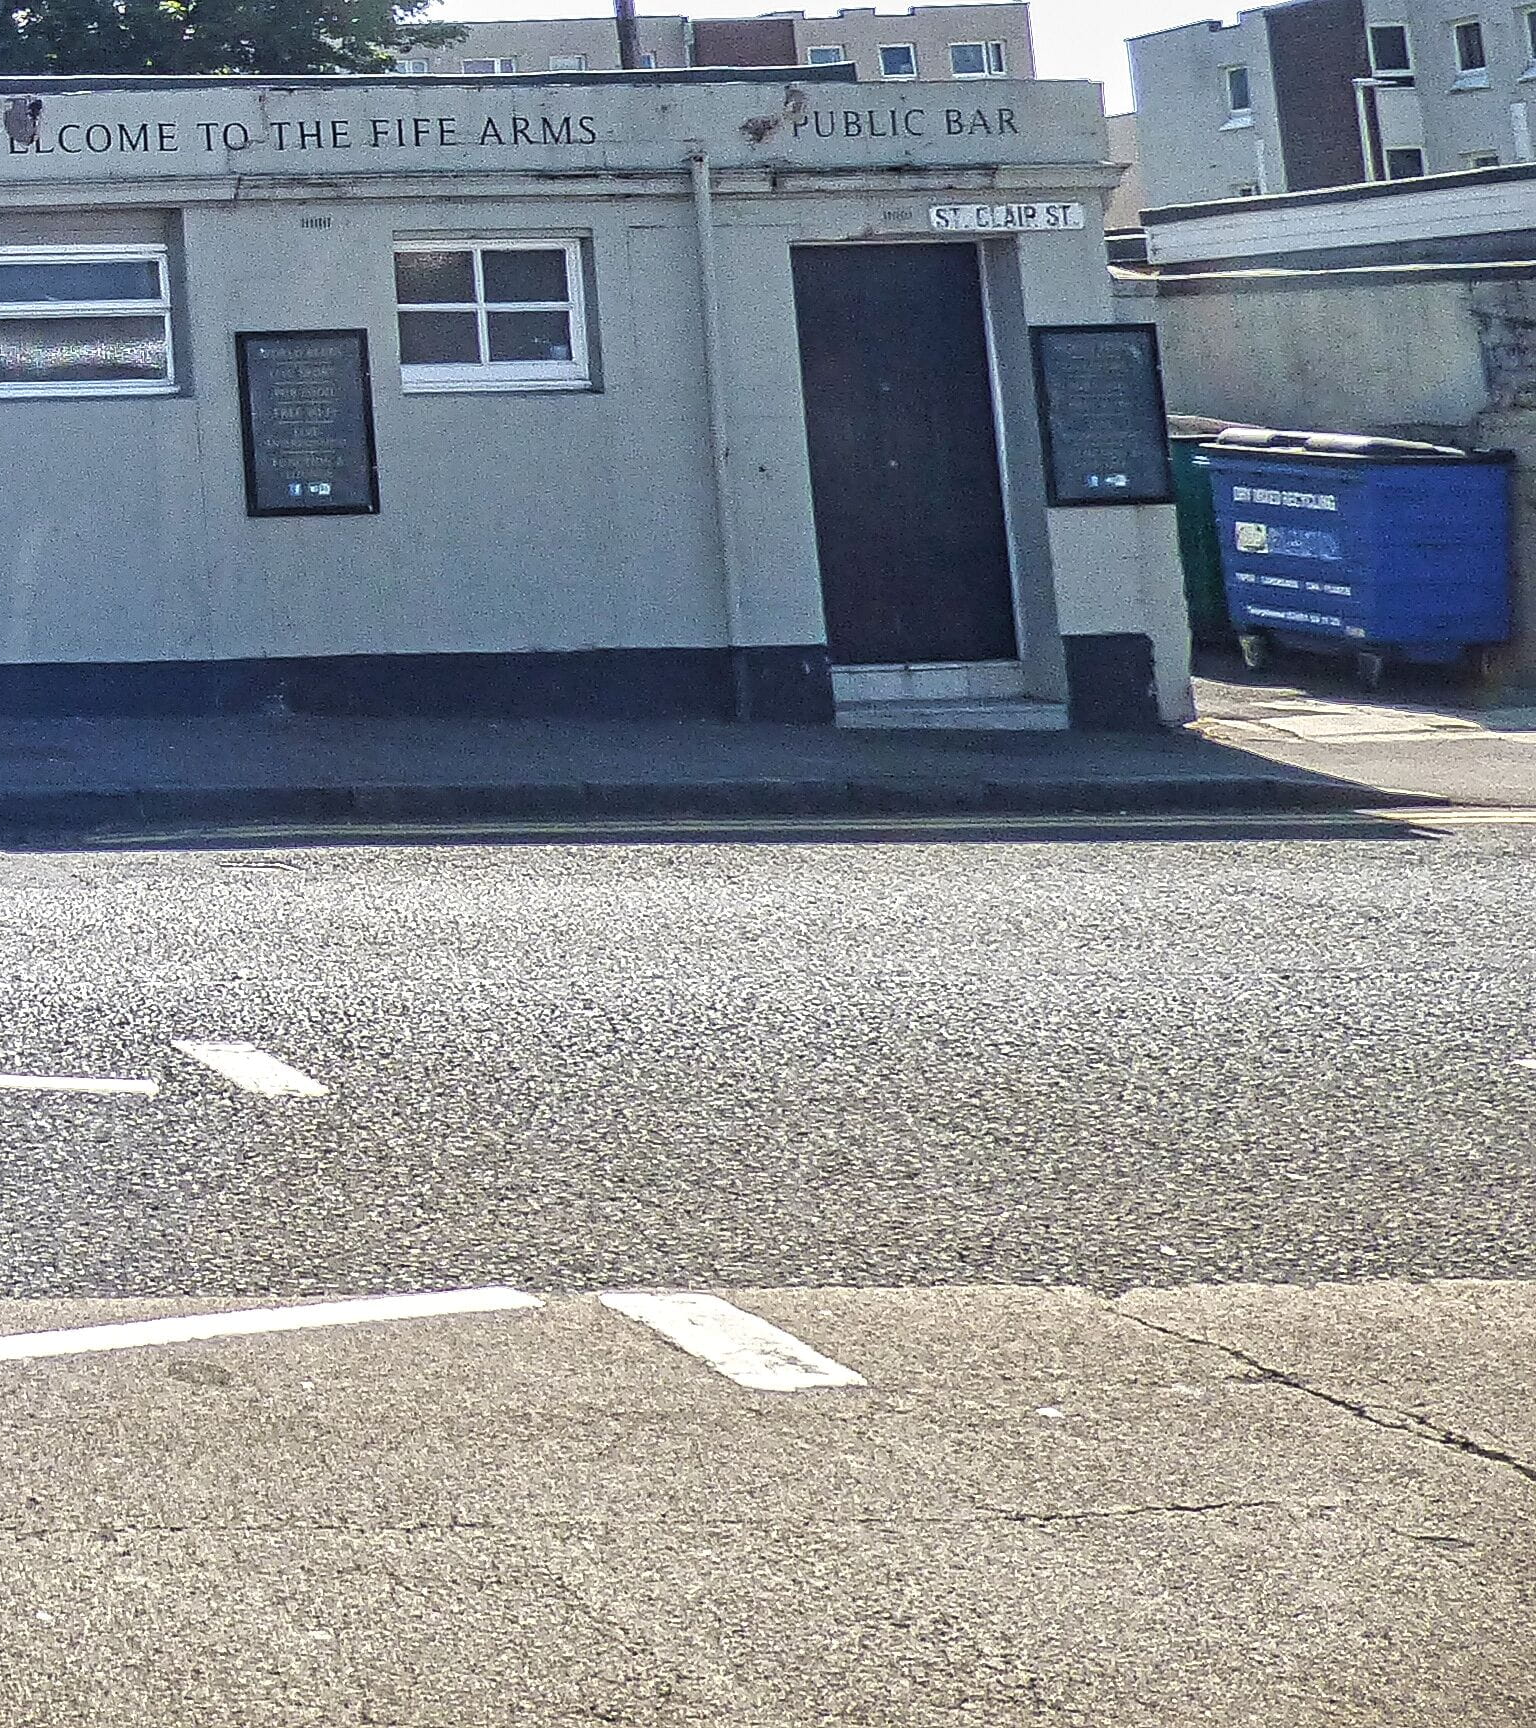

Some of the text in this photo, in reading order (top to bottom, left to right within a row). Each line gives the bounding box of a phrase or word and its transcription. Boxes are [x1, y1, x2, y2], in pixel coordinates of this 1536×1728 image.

[197, 121, 250, 152] TO
[270, 119, 351, 151] THE
[369, 117, 457, 148] FIFE
[478, 115, 598, 147] ARMS
[791, 107, 1020, 138] PUBLIC BAR
